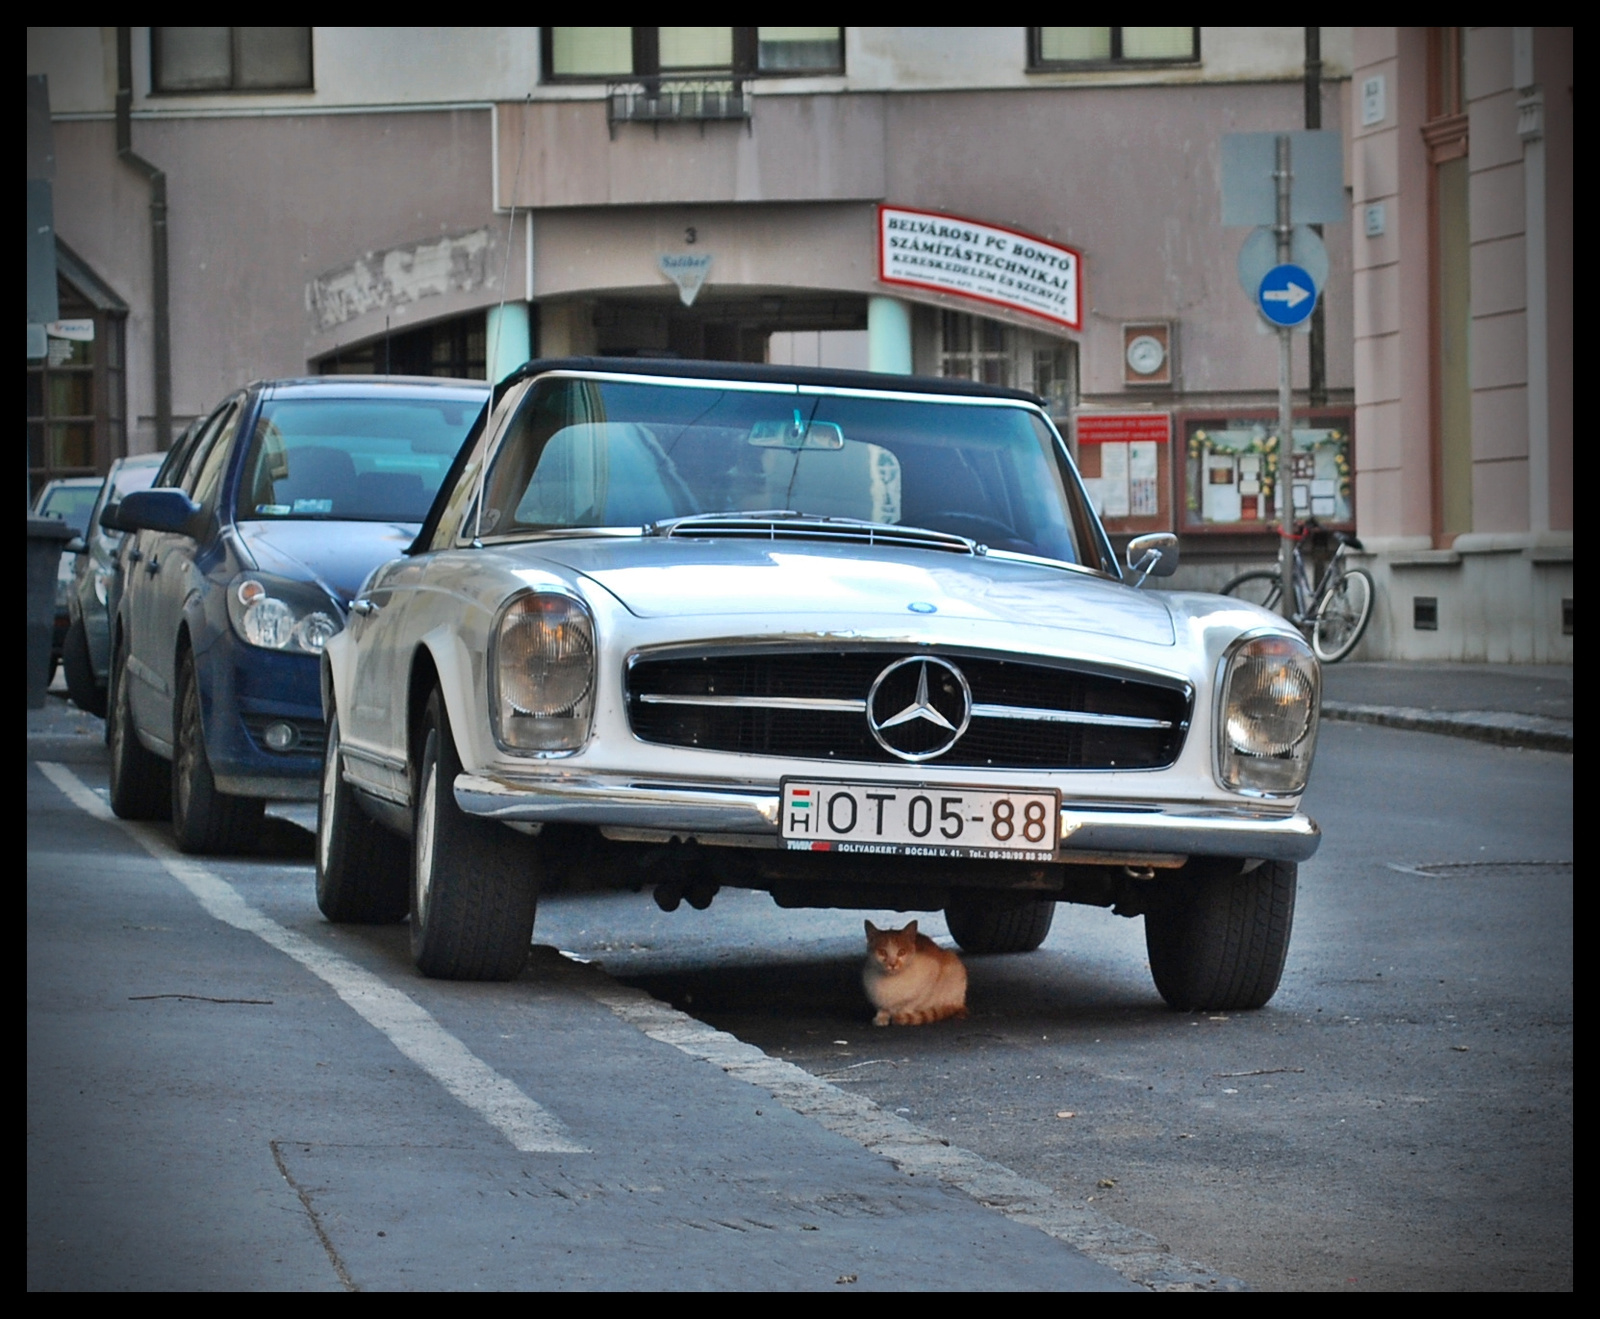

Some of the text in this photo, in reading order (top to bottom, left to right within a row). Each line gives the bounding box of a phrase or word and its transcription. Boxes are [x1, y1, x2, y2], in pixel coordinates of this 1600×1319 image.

[685, 226, 697, 244] 3
[888, 217, 1071, 271] BELVÁROSI PC BONTÓ
[889, 236, 1069, 290] SZÁMÍTÁSTECHNIKAI
[892, 253, 997, 282] KERESKEDELEM
[999, 274, 1014, 287] ÉS
[1016, 279, 1068, 305] SZERVÍZ
[790, 812, 809, 832] H
